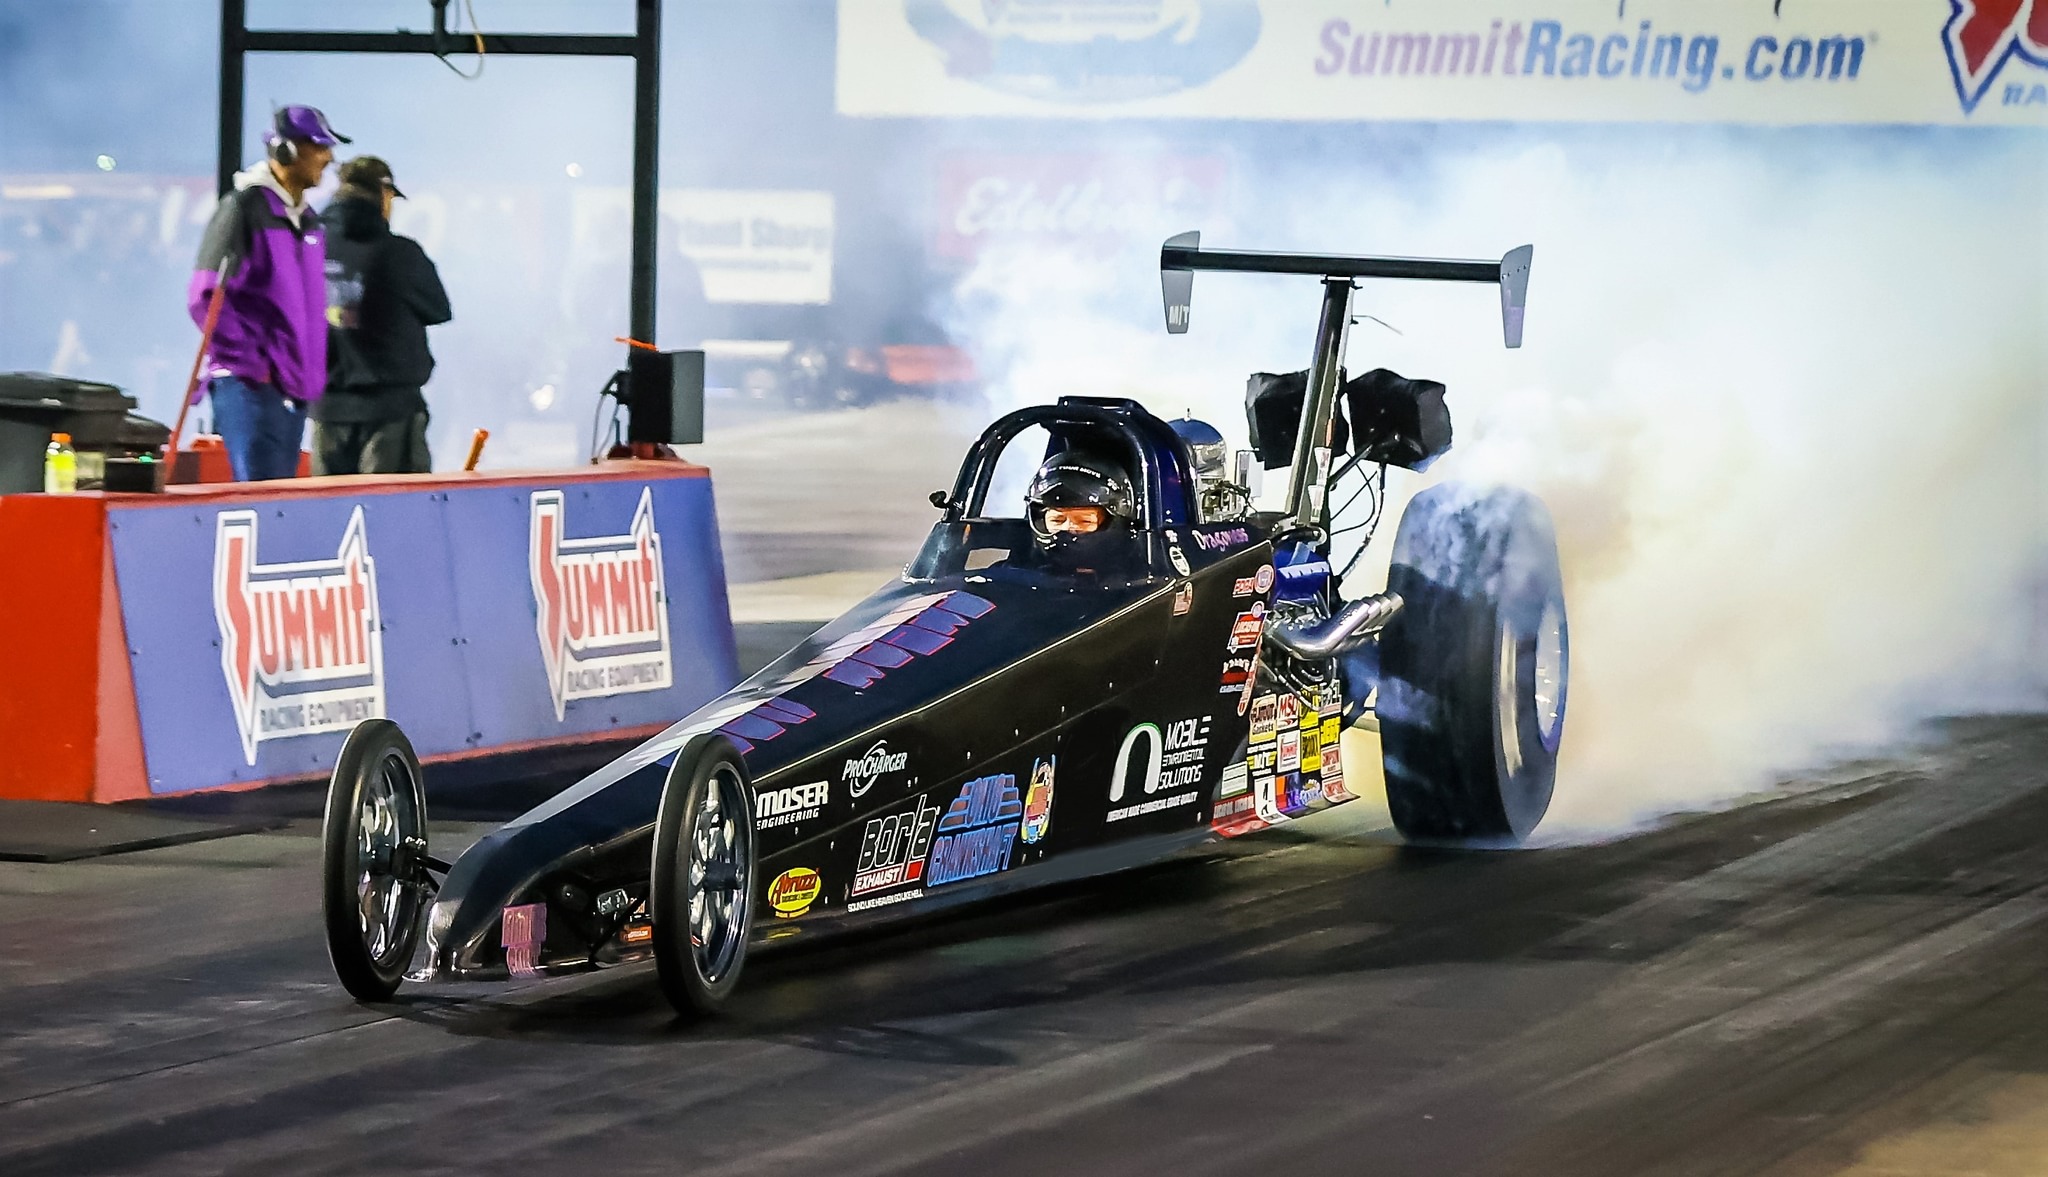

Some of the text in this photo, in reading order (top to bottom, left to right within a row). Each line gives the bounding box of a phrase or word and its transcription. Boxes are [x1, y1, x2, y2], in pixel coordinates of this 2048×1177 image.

[1315, 16, 1866, 92] SummitRacing.com
[1168, 304, 1189, 325] M/T
[540, 513, 656, 665] SUMMIT
[224, 533, 367, 706] SUMMIT
[568, 661, 664, 693] RACING EQUIPMENT
[260, 697, 375, 732] RACING EQUIPMENT
[1164, 716, 1212, 752] MOBILE
[841, 752, 908, 781] PROCHARGER
[1158, 764, 1203, 790] SOLUTIONS
[755, 780, 829, 818] MOSER
[857, 794, 938, 873] Borla
[854, 868, 901, 892] EXHAUST
